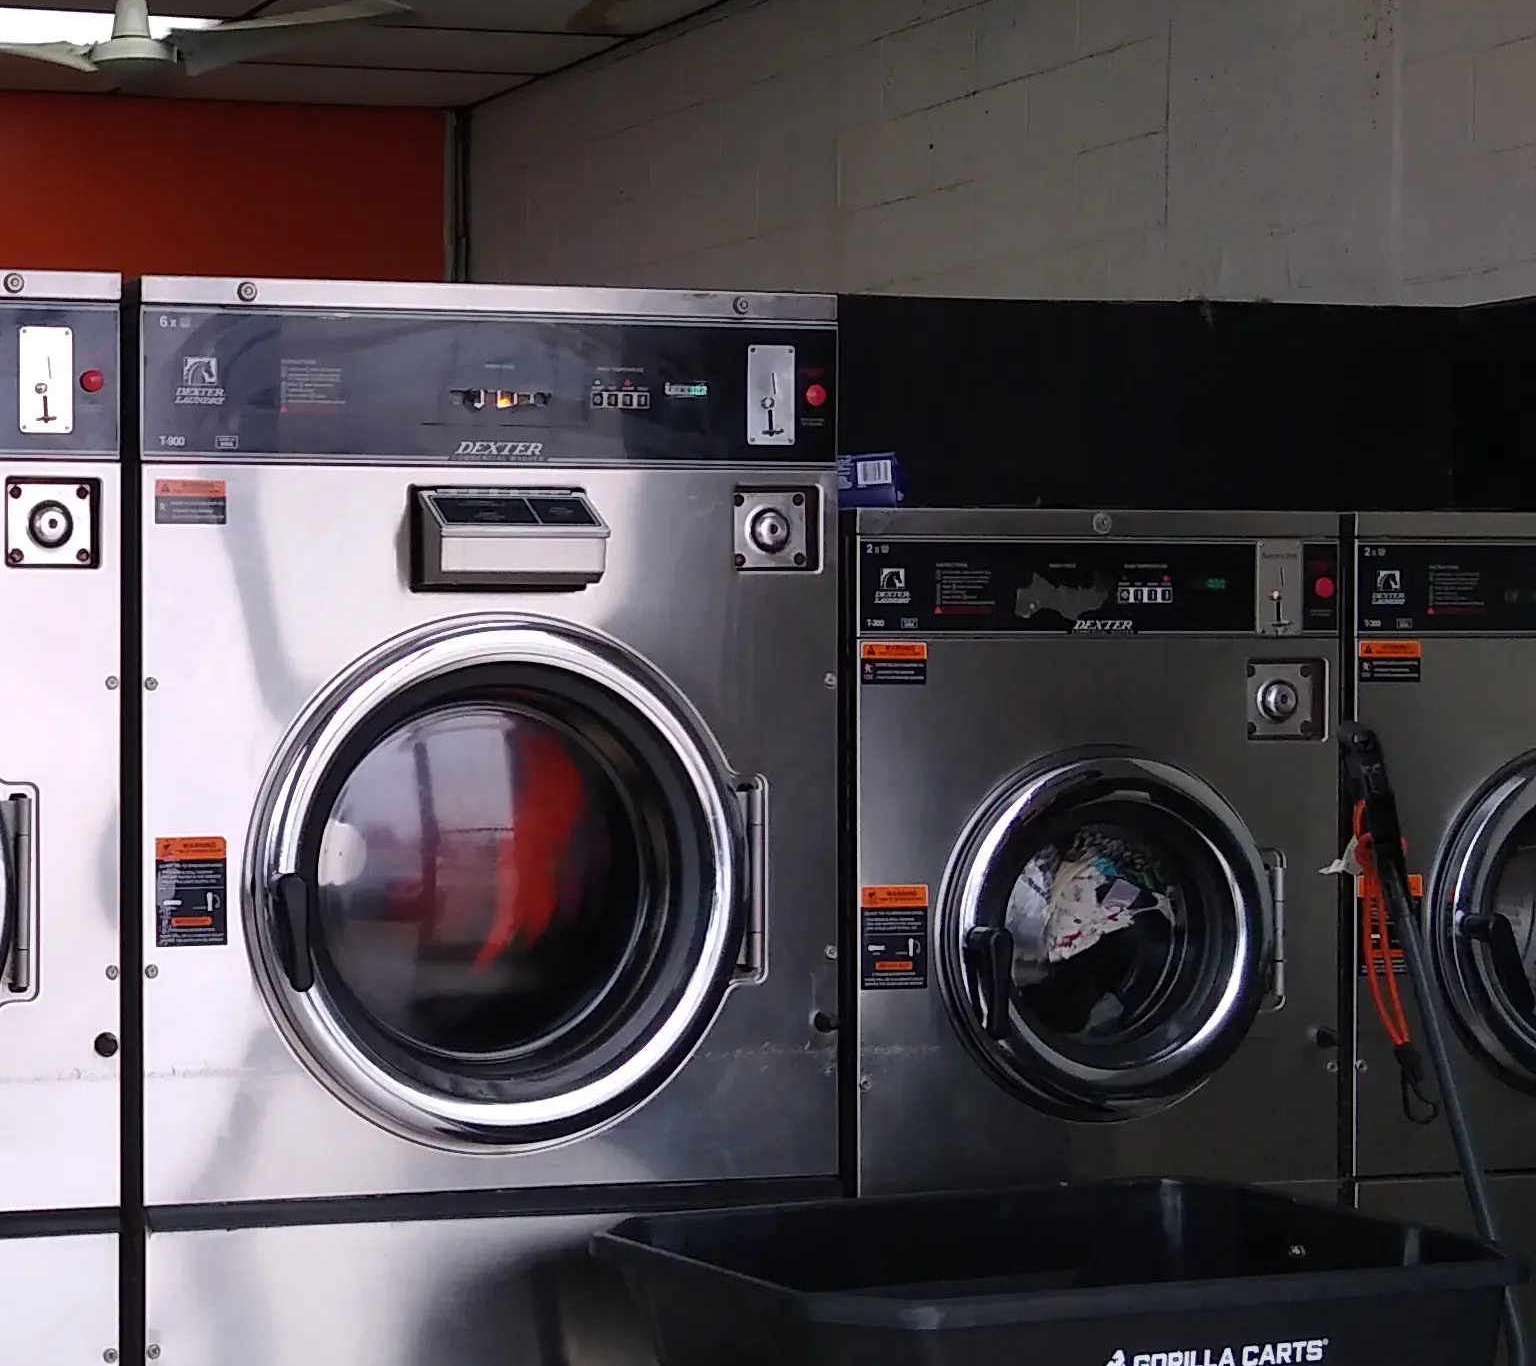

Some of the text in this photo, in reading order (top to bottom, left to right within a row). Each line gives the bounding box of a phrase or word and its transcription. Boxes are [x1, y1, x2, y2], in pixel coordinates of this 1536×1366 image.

[159, 316, 168, 328] 6
[175, 387, 225, 397] DEXTER
[159, 436, 185, 446] T-900
[454, 441, 544, 456] DEXTER
[866, 544, 874, 554] 2
[1364, 547, 1371, 557] 2
[1073, 619, 1133, 630] DEXTER
[1242, 1339, 1324, 1366] CARTS
